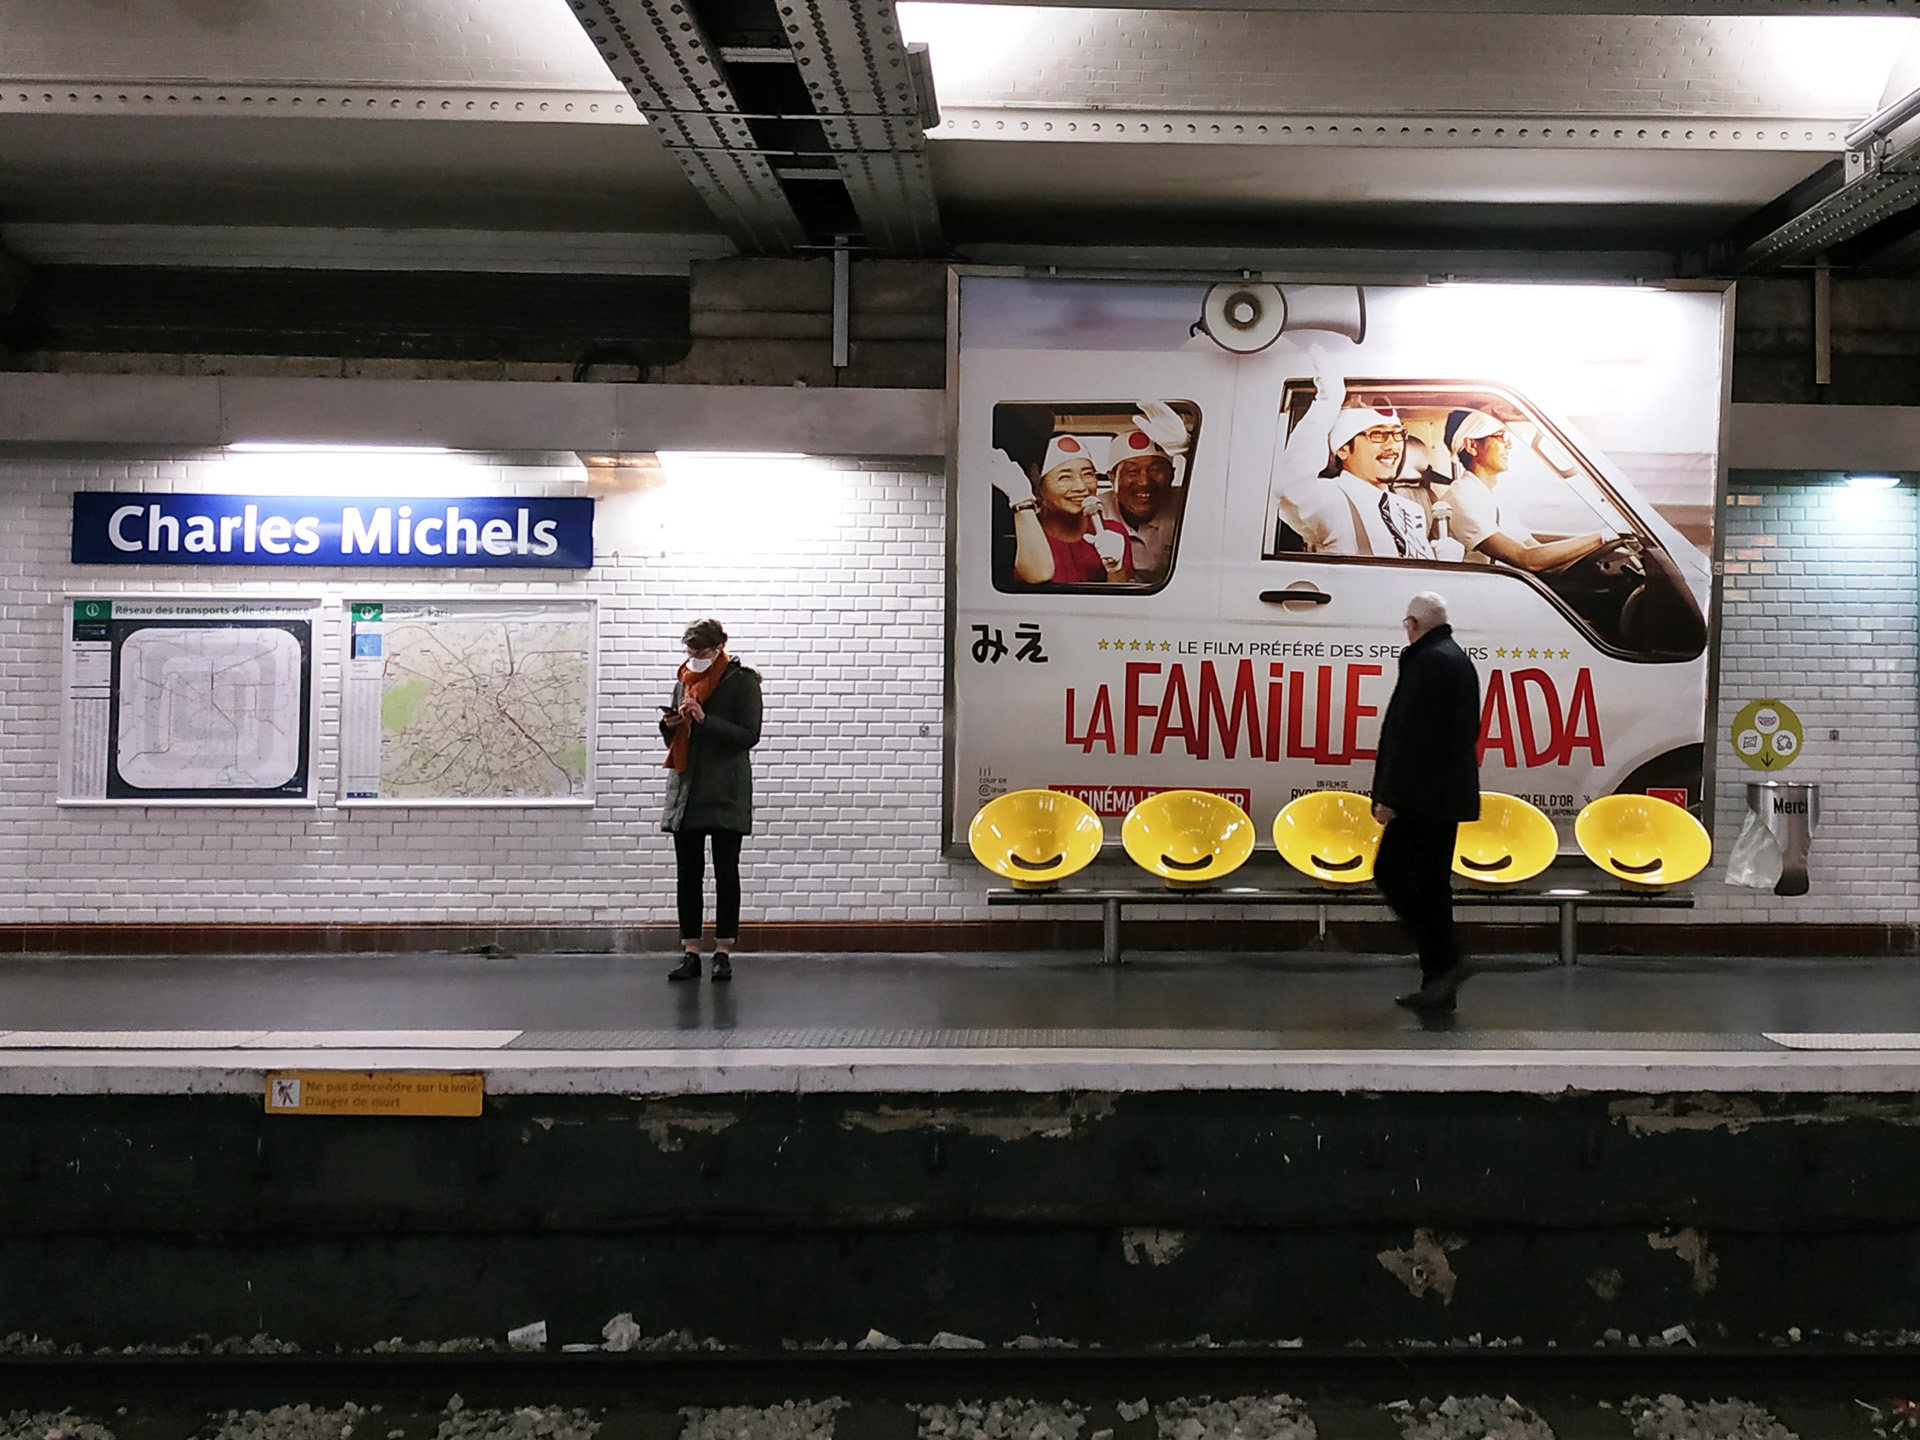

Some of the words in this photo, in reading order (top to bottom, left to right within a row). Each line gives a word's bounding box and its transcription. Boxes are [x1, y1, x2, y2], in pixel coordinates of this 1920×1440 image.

[108, 504, 320, 554] Charles
[341, 505, 558, 556] Michels
[115, 605, 151, 615] Réseau
[155, 605, 173, 615] des
[176, 605, 229, 616] transports
[971, 623, 1048, 664] みえ
[1178, 641, 1198, 654] LE
[1203, 641, 1243, 655] FILM
[1250, 640, 1325, 657] PRÉFÉRÉ
[1331, 644, 1363, 658] DES
[1065, 684, 1116, 754] LA
[1550, 794, 1574, 807] D'OR
[326, 1083, 348, 1093] pas
[416, 1084, 434, 1093] sur
[305, 1097, 348, 1109] Danger
[352, 1097, 368, 1107] de
